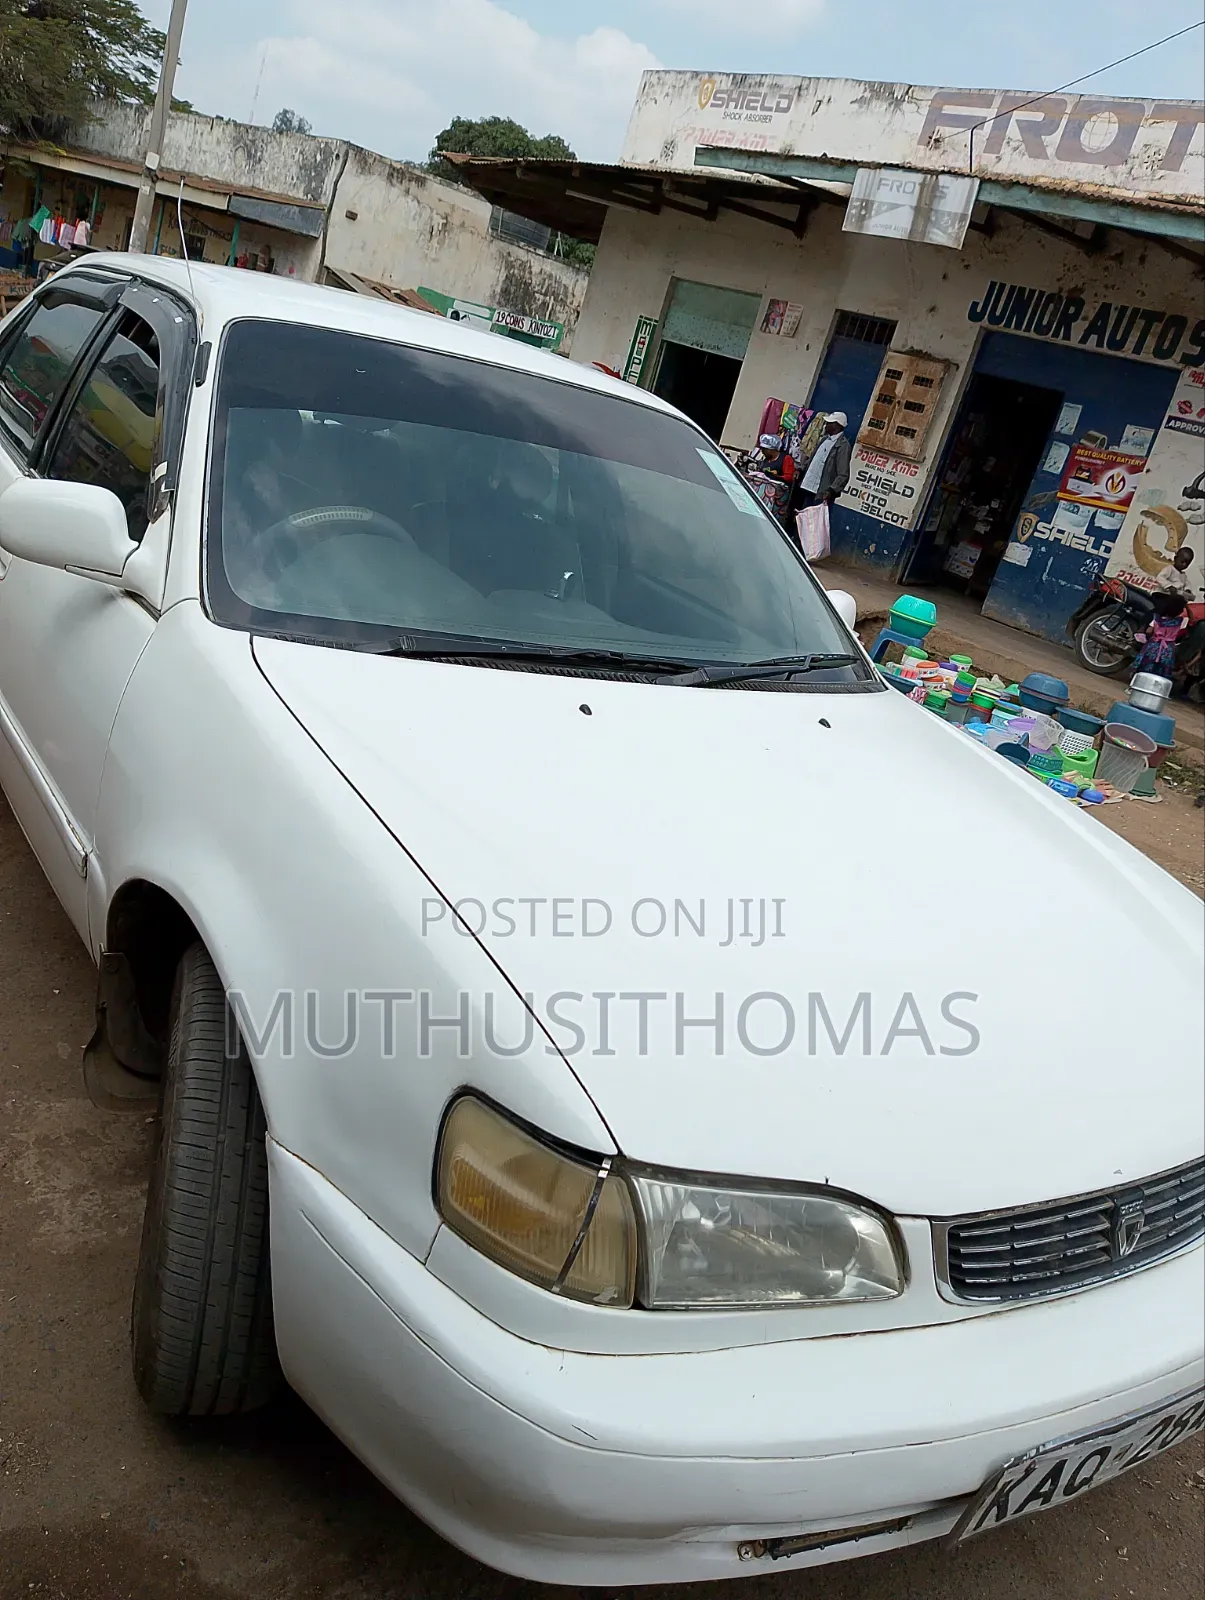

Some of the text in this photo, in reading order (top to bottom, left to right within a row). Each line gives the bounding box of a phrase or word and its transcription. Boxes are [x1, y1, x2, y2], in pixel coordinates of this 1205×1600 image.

[709, 89, 796, 114] SHIELD
[722, 111, 773, 124] SHOCK ABSORBER
[967, 280, 1086, 342] JUNIOR
[1078, 301, 1194, 361] AUTO
[855, 449, 889, 468] POWER
[1076, 448, 1091, 458] BEST
[1091, 450, 1117, 463] QUALITY
[1116, 456, 1143, 467] BATTERY
[855, 469, 915, 499] SHIELD
[973, 1446, 1113, 1531] KAQ
